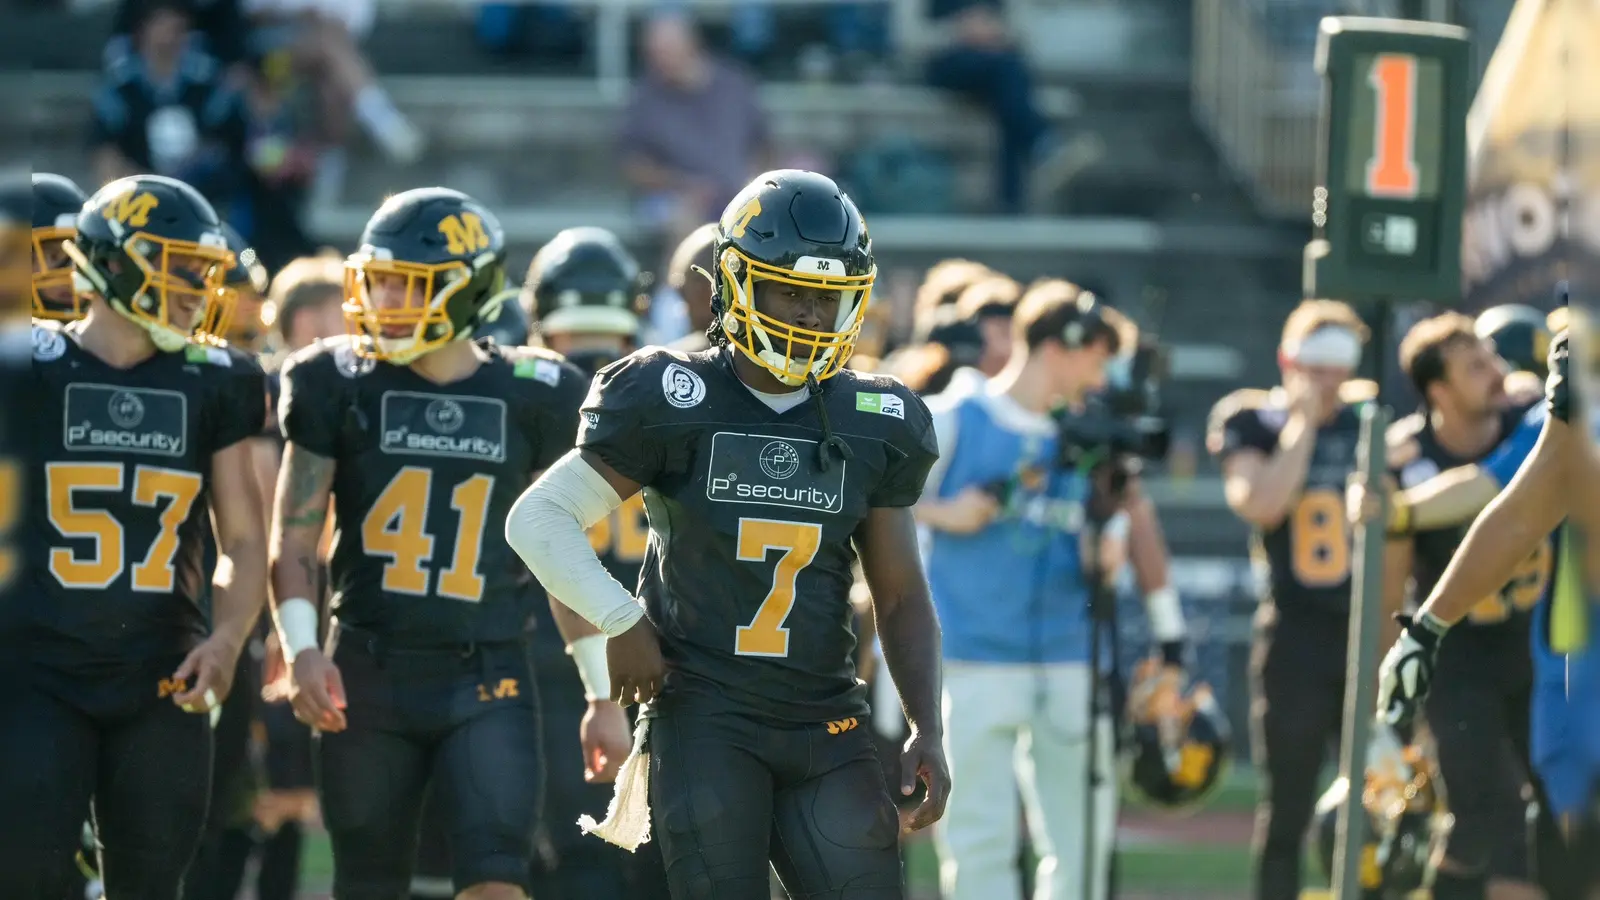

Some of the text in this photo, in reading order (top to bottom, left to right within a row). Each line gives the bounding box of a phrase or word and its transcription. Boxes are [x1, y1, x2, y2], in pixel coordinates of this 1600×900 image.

[1367, 53, 1419, 198] 1
[104, 190, 158, 228] M
[438, 211, 489, 255] M
[817, 260, 830, 271] M
[45, 461, 203, 593] 57
[362, 466, 496, 603] 41
[736, 483, 838, 509] security
[1291, 486, 1351, 588] 8
[735, 517, 822, 657] 7
